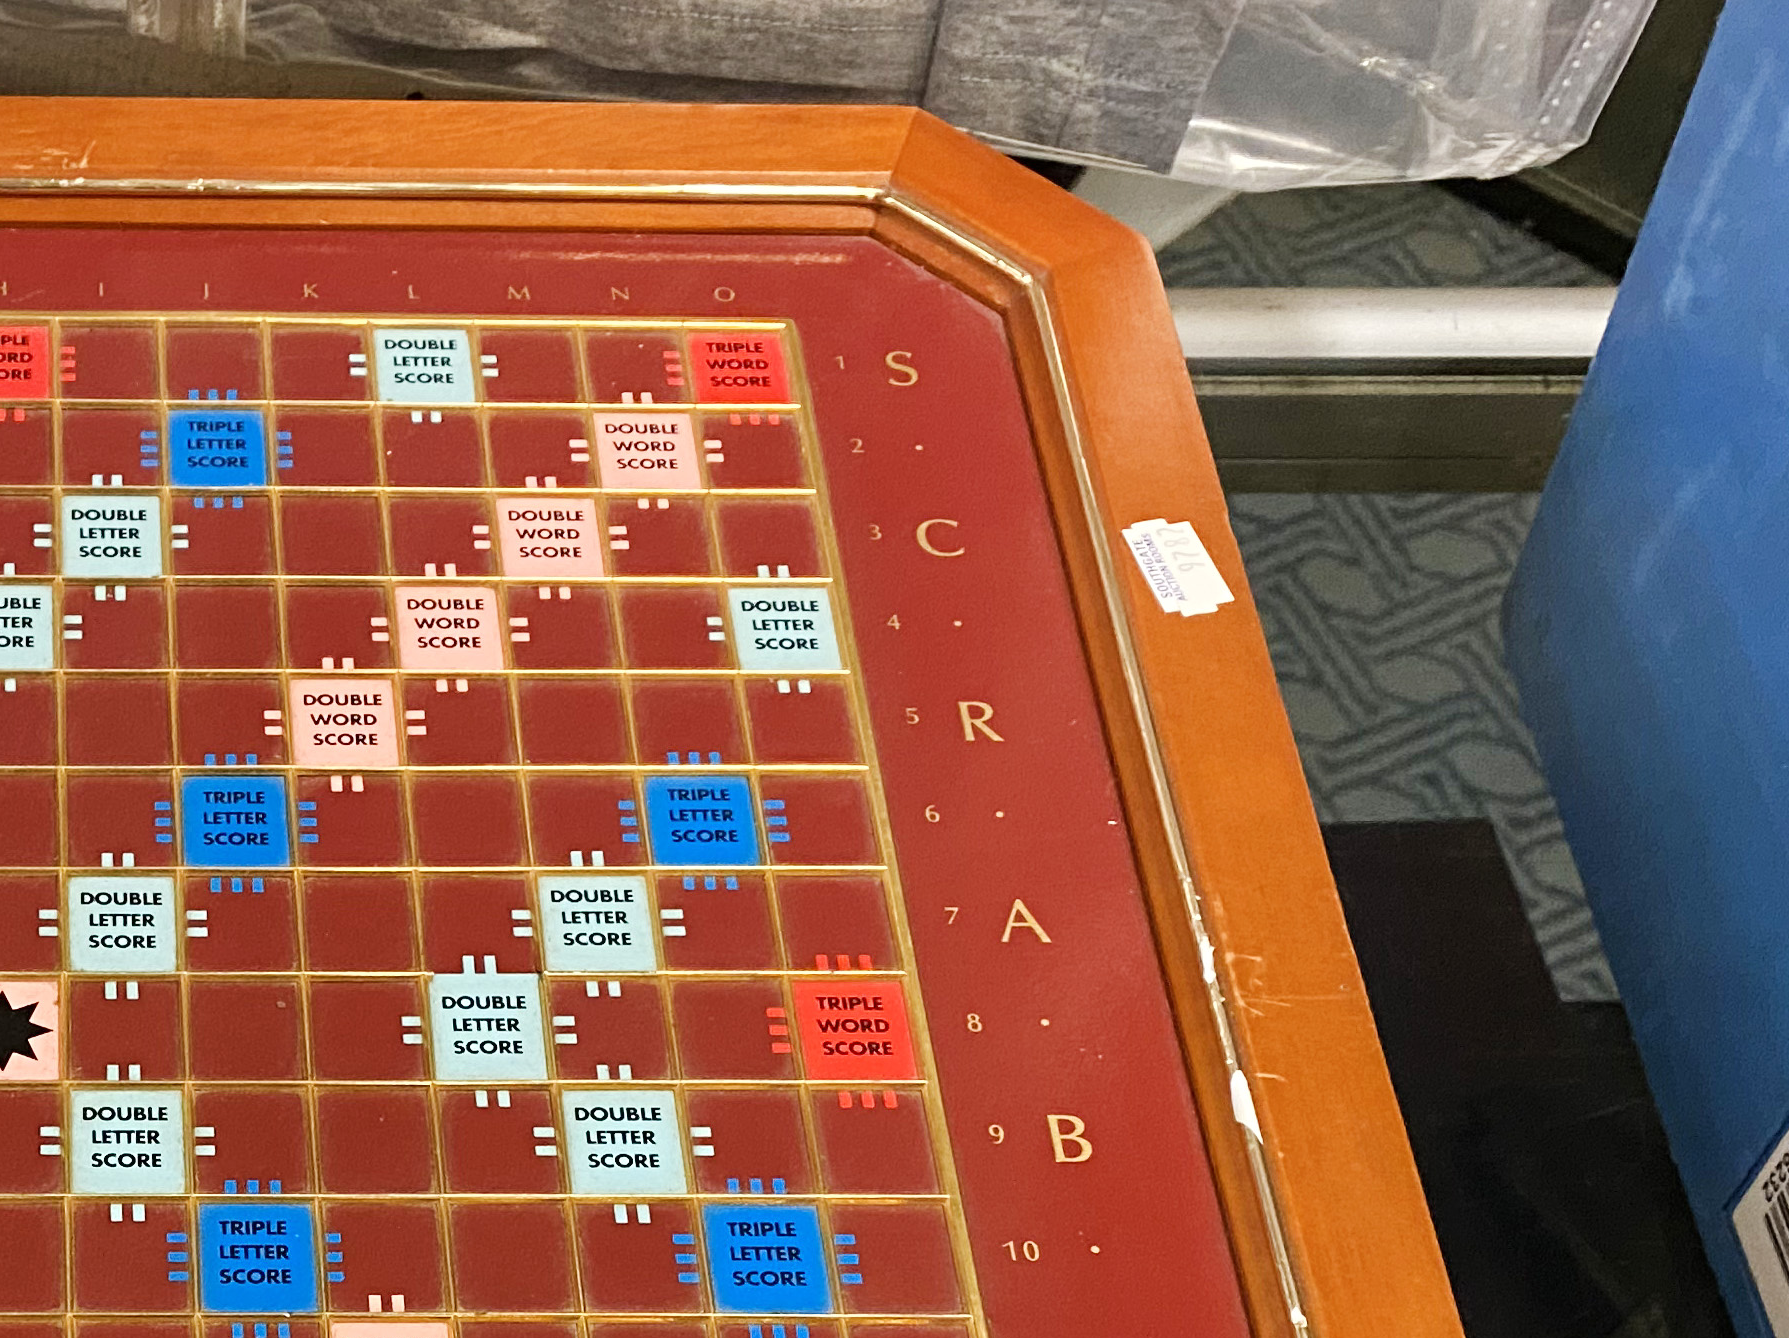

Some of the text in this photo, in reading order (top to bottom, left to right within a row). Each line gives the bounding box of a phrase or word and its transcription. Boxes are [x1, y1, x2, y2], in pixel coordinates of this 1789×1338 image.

[302, 282, 320, 300] K
[506, 284, 532, 302] M
[609, 285, 631, 302] N
[712, 285, 737, 304] O
[706, 341, 764, 354] TRIPLE
[706, 358, 770, 371] WORD
[709, 375, 771, 388] SCORE
[849, 436, 866, 455] 2
[507, 509, 584, 522] DOUBLE
[515, 527, 581, 541] WORD
[868, 522, 884, 542] 3
[518, 545, 583, 559] SCORE
[1131, 539, 1173, 599] SOUTHGATE
[1141, 532, 1188, 601] AUCTION ROOMS
[740, 599, 820, 613] DOUBLE
[751, 618, 815, 632] LETTER
[885, 612, 902, 632] 4
[753, 636, 820, 651] SCORE
[904, 706, 921, 726] 5
[202, 790, 266, 806] TRIPLE
[202, 810, 268, 826] LETTER
[923, 803, 942, 824] 6
[202, 831, 270, 847] SCORE
[549, 888, 635, 904] DOUBLE
[560, 910, 629, 925] LETTER
[942, 905, 961, 926] 7
[562, 931, 633, 947] SCORE
[816, 995, 884, 1012] TRIPLE
[816, 1018, 890, 1034] WORD
[965, 1011, 984, 1034] 8
[822, 1040, 892, 1057] SCORE
[987, 1122, 1006, 1146] 9
[1001, 1239, 1041, 1263] 10
